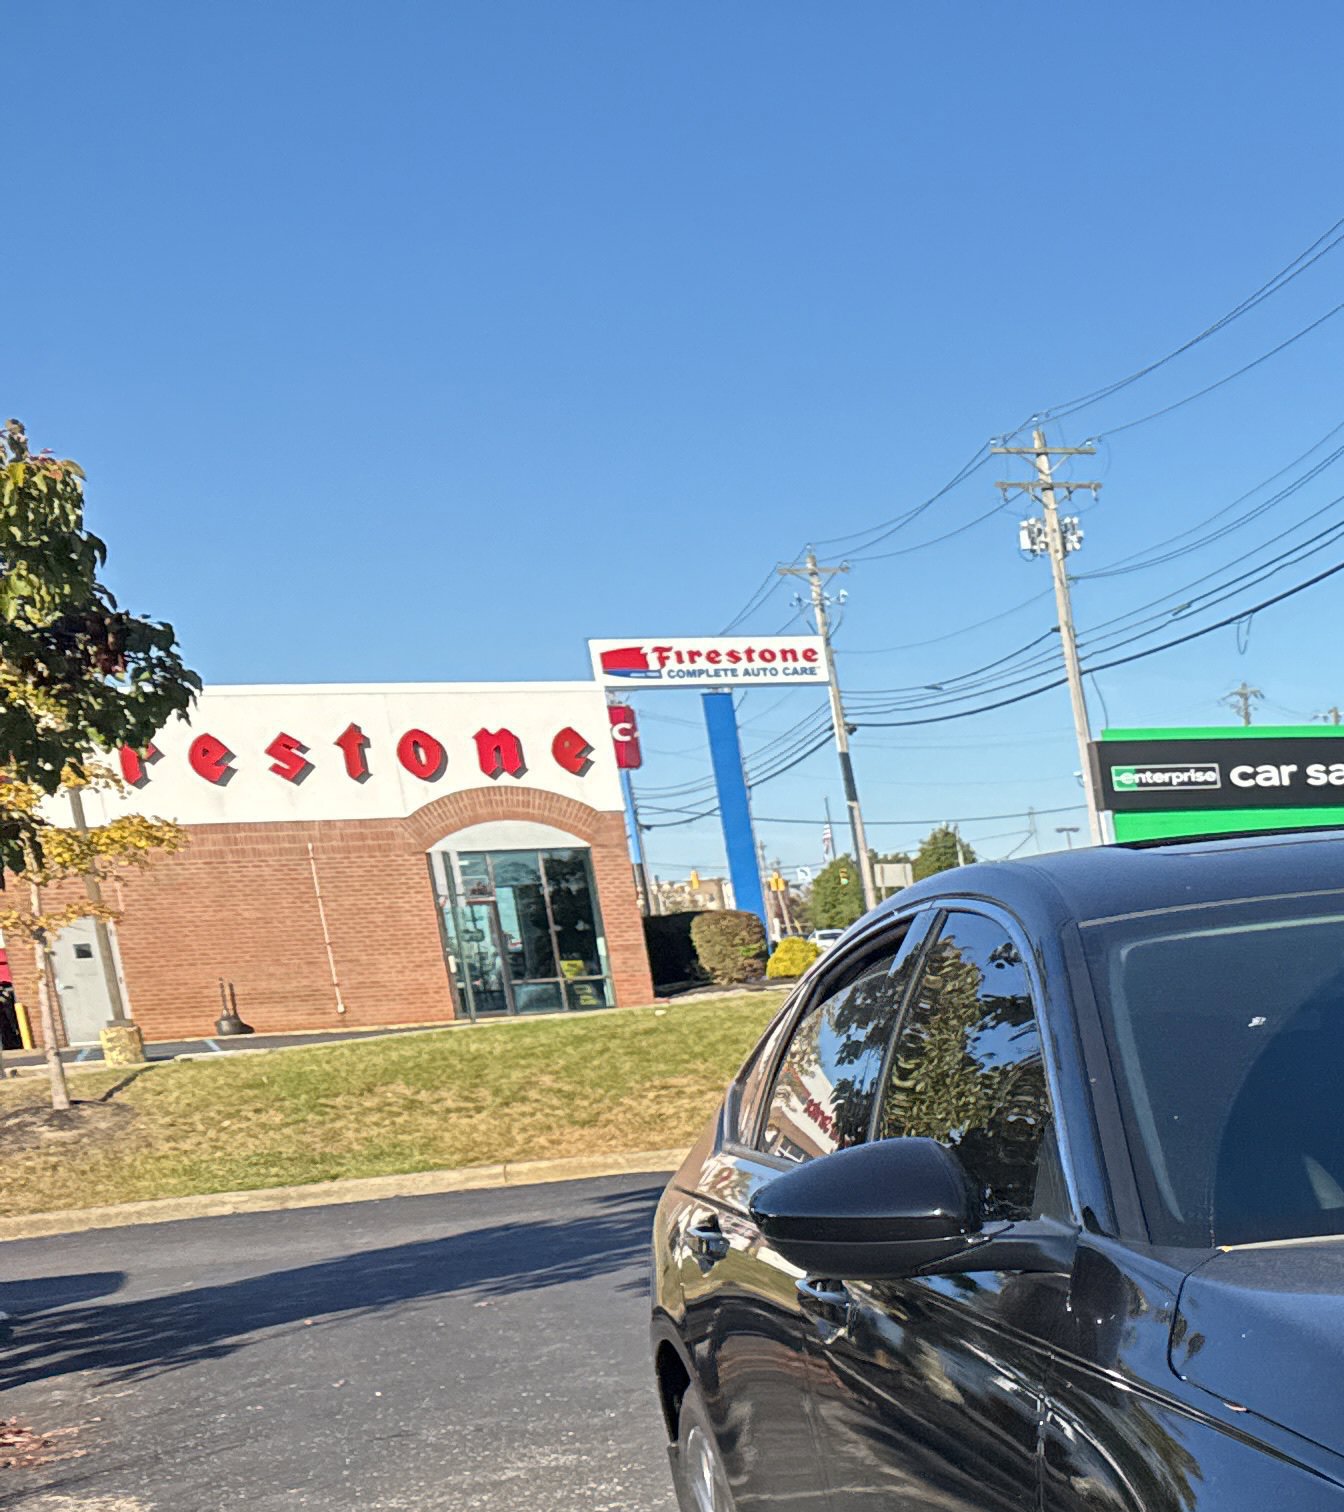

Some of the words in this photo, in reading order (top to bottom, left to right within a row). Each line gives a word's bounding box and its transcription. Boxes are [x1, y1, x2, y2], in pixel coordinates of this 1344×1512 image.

[651, 646, 819, 669] Firestone
[667, 668, 739, 679] COMPLETE
[742, 667, 778, 677] AUTO
[782, 667, 817, 676] CARE
[1118, 768, 1218, 786] enterprise
[1229, 763, 1298, 788] car
